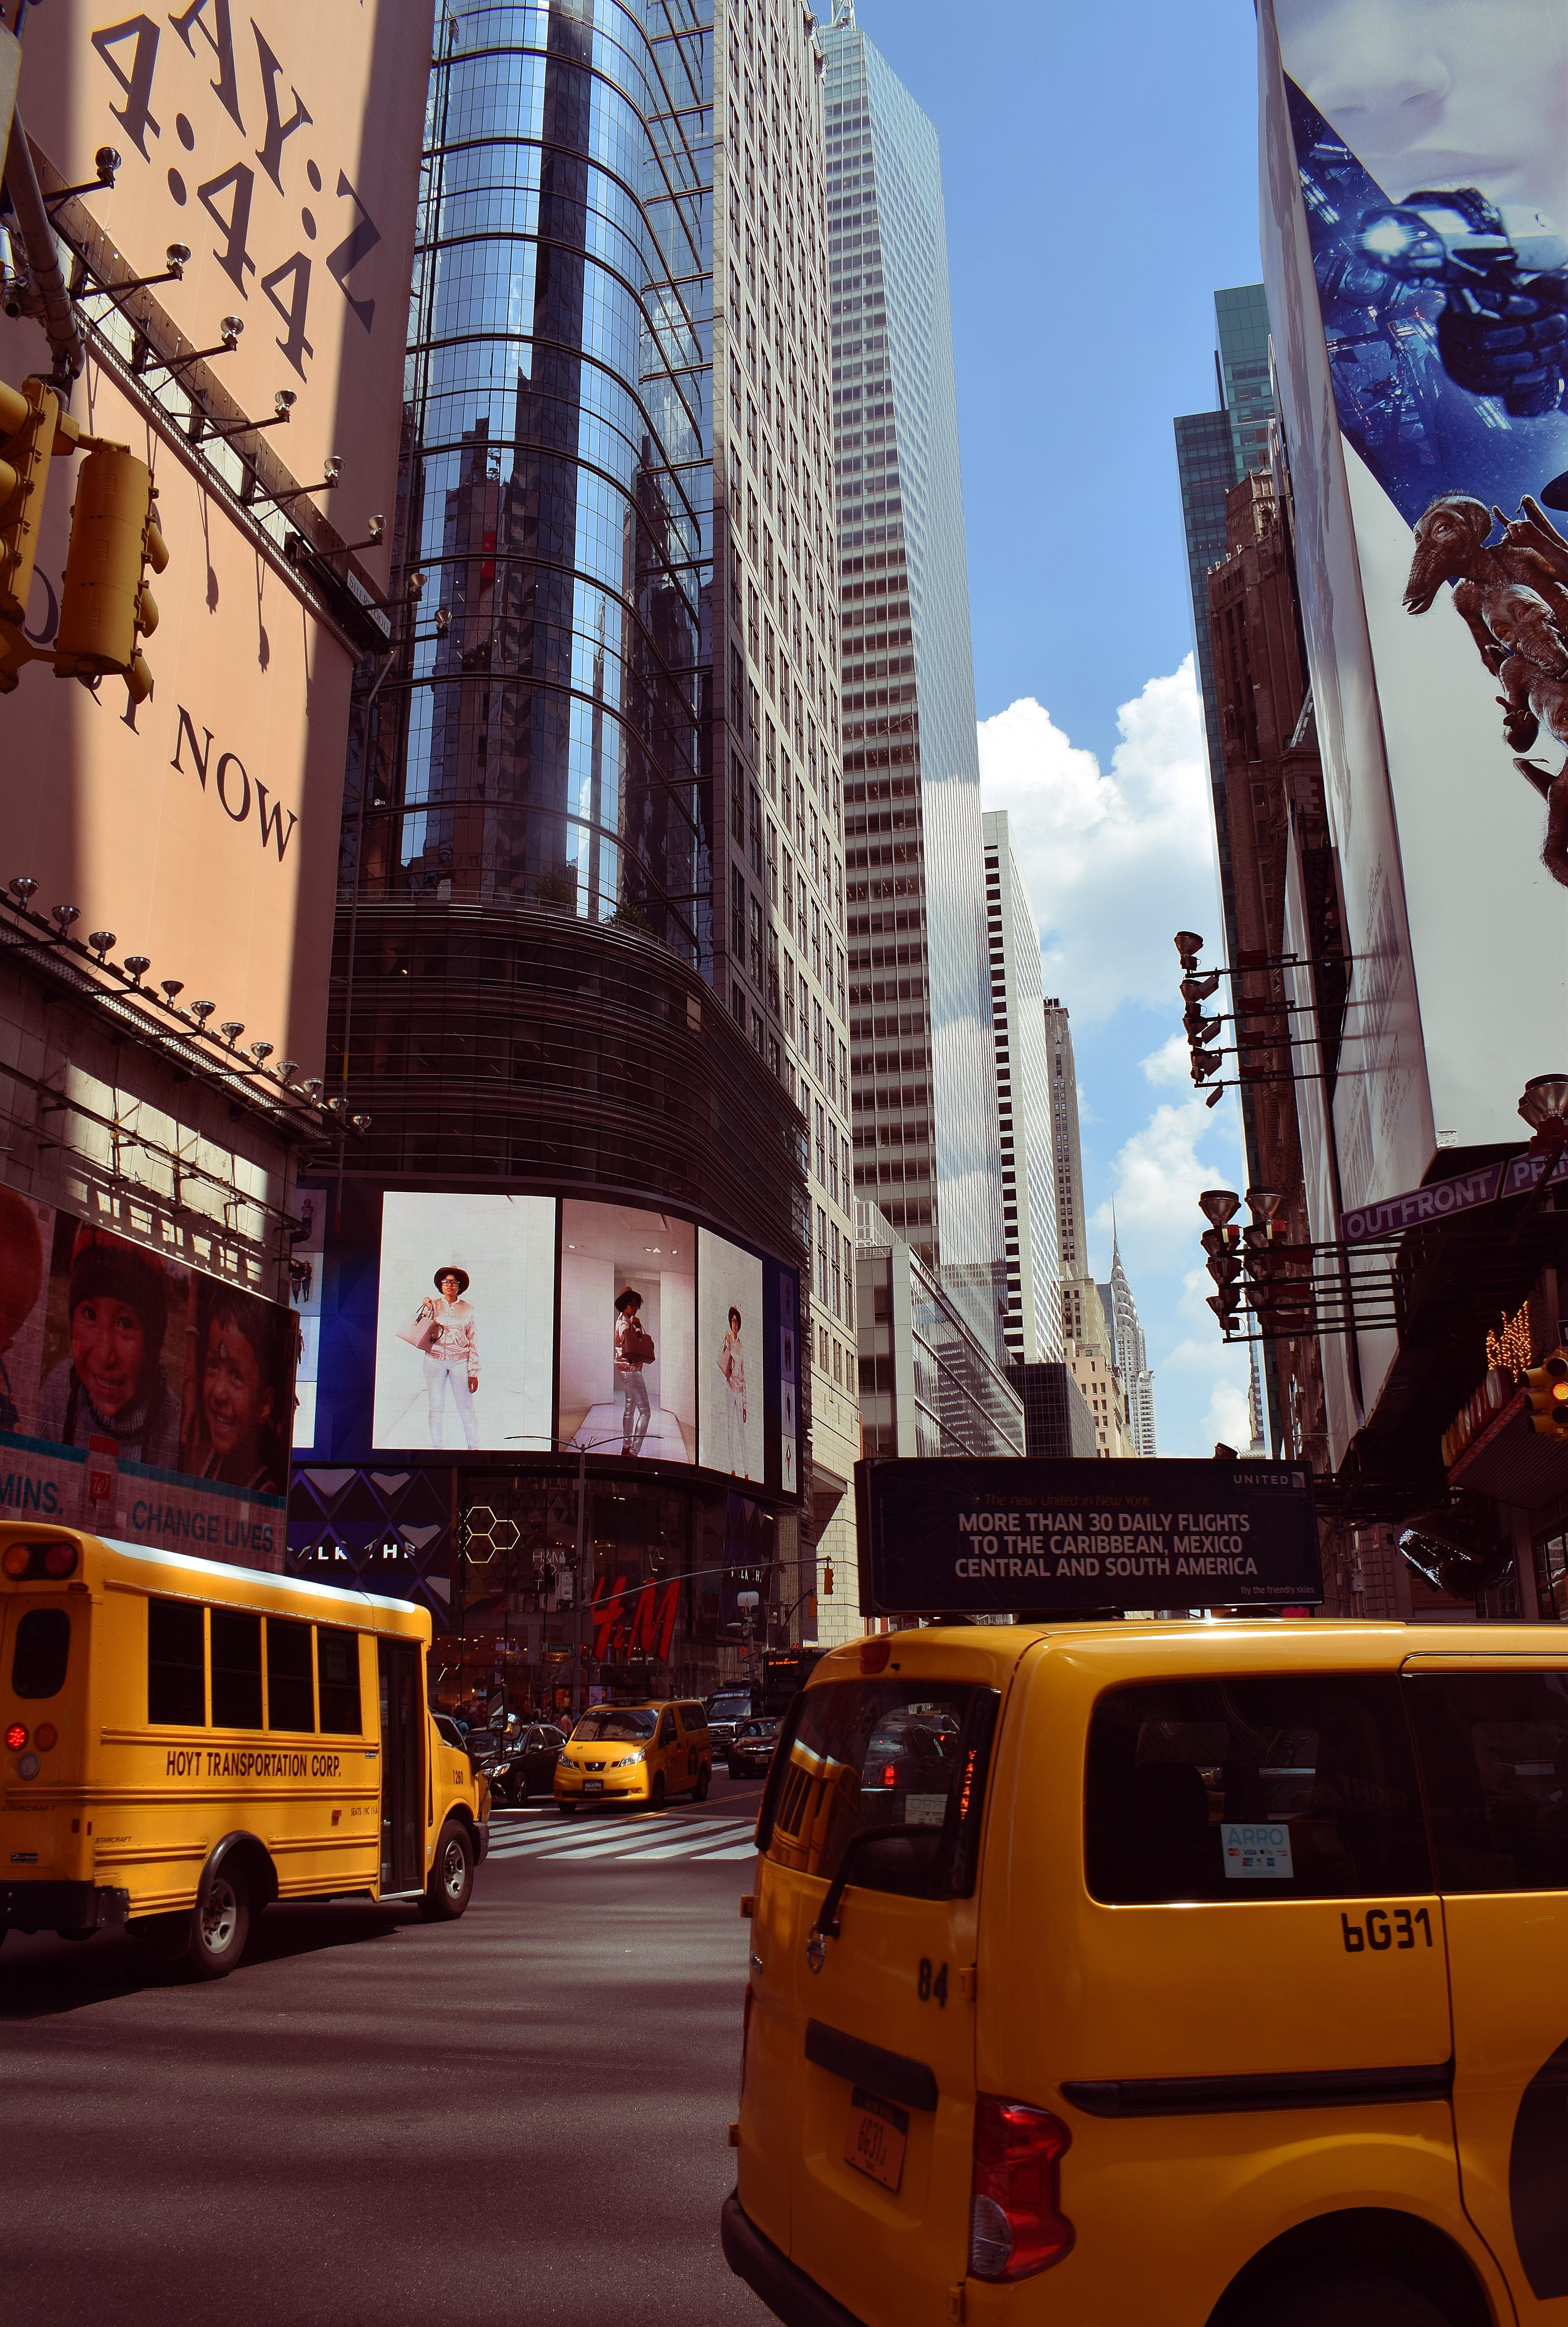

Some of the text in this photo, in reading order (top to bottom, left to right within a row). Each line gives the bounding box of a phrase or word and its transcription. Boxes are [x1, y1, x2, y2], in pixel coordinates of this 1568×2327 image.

[170, 704, 298, 862] NOW
[1347, 1171, 1493, 1238] OUTFRONT
[1233, 1474, 1289, 1484] UNITED
[985, 1494, 1150, 1506] The new United in New York
[132, 1500, 277, 1554] CHANGE LIVES.
[959, 1513, 1250, 1532] MORE THAN 30 DAILY FLIGHTS
[969, 1535, 1243, 1557] TO THE CARIBBEAN, MEXICO
[955, 1557, 1258, 1577] CENTRAL AND SOUTH AMERICA
[1241, 1585, 1251, 1595] fly
[1267, 1585, 1295, 1595] friendly
[1296, 1585, 1314, 1594] skies
[588, 1574, 681, 1662] H&M
[166, 1751, 341, 1777] HOYT TRANSPORTATION CORP.
[453, 1770, 463, 1784] 1260
[960, 1750, 978, 1819] VACANT
[351, 1807, 361, 1816] SEATS
[1228, 1828, 1283, 1845] ARRO
[918, 1958, 948, 2008] 84
